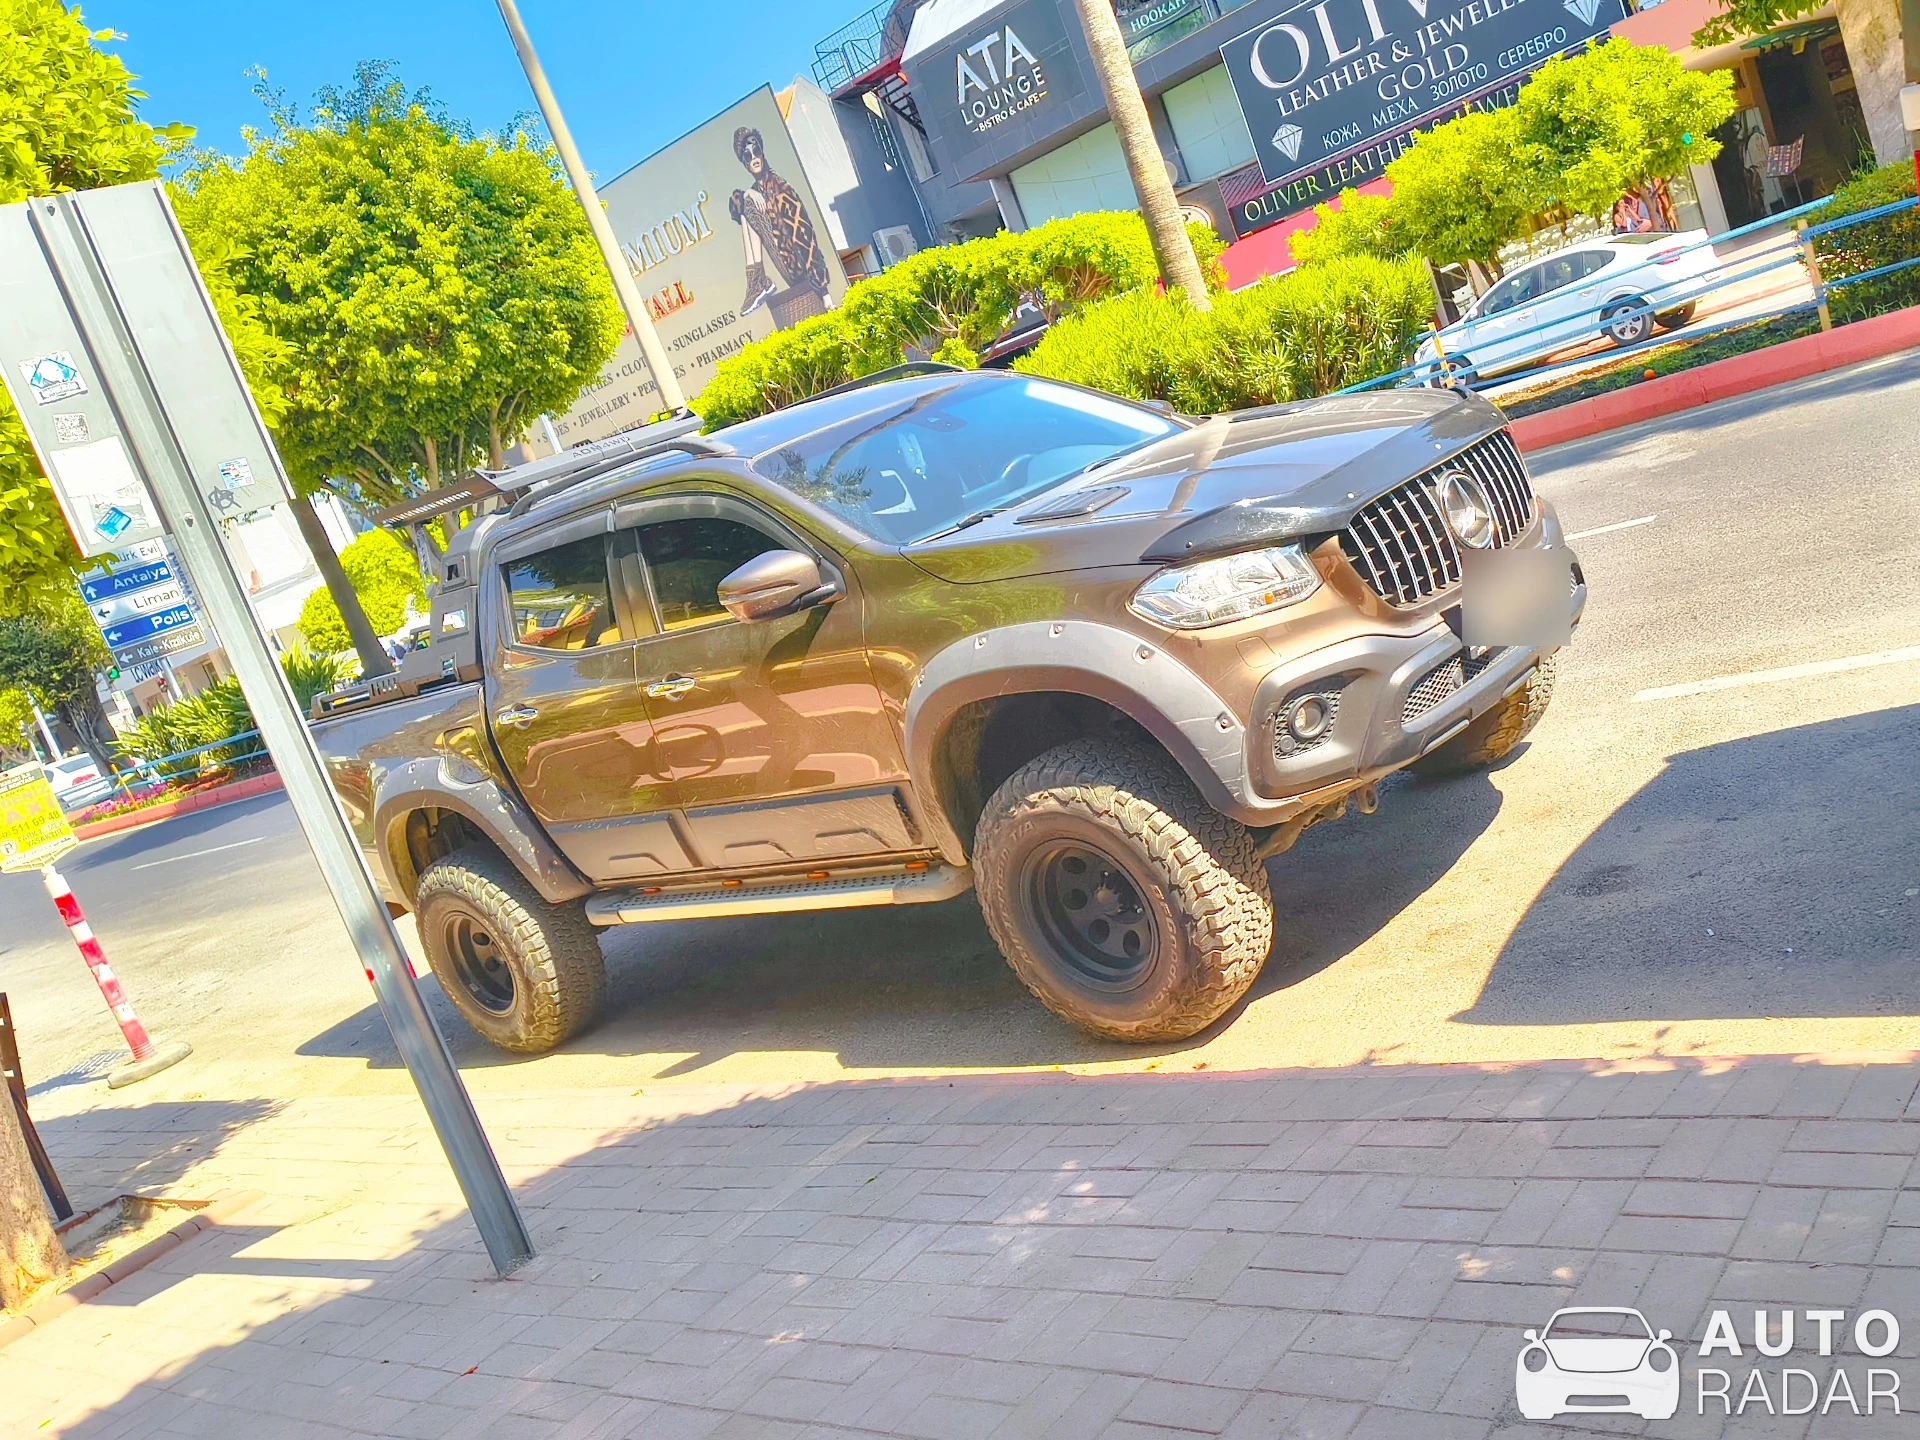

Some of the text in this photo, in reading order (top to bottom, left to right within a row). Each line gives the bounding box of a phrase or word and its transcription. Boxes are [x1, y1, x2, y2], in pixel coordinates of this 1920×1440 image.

[956, 24, 1039, 105] ATA
[1275, 52, 1389, 117] LEATHER
[1391, 40, 1413, 63] &
[1321, 26, 1567, 150] КОЖА МЕХА ЗОЛОТО СЕРЕБРО
[1377, 43, 1469, 100] GOLD
[961, 66, 1045, 126] LOUNGE
[978, 92, 1040, 132] BISTRO & CAFE
[1244, 174, 1324, 221] OLIVER
[672, 310, 737, 352] SUNGLASSES
[578, 392, 630, 428] JEWELLERY
[696, 330, 753, 368] PHARMACY
[139, 544, 159, 557] Evi
[114, 566, 169, 590] Antalya
[133, 588, 180, 609] Liman
[11, 822, 31, 836] 511
